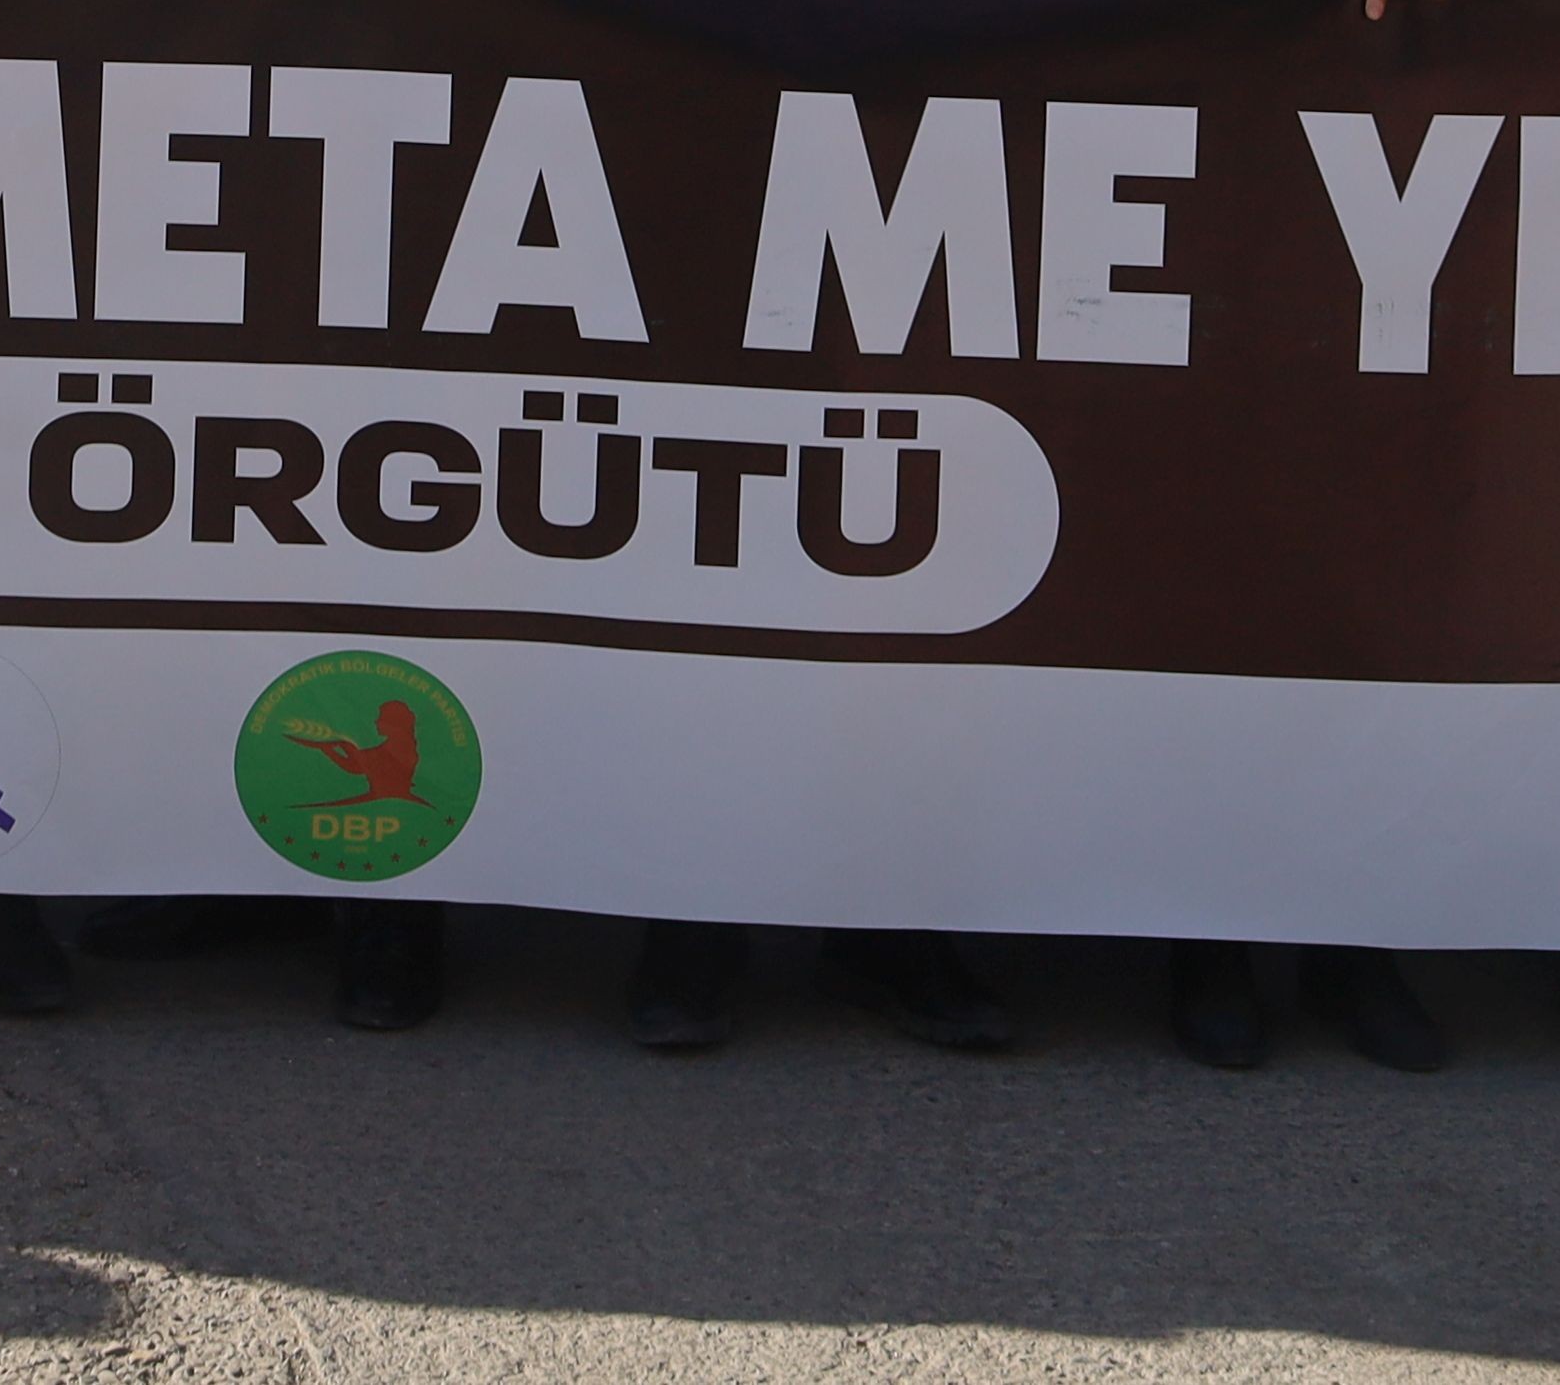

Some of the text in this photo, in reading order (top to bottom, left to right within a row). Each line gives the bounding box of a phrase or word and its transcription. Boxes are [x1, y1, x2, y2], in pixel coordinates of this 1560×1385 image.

[742, 90, 1199, 367] ME
[28, 372, 941, 578] ÖRGÜTÜ
[311, 813, 401, 843] DBP
